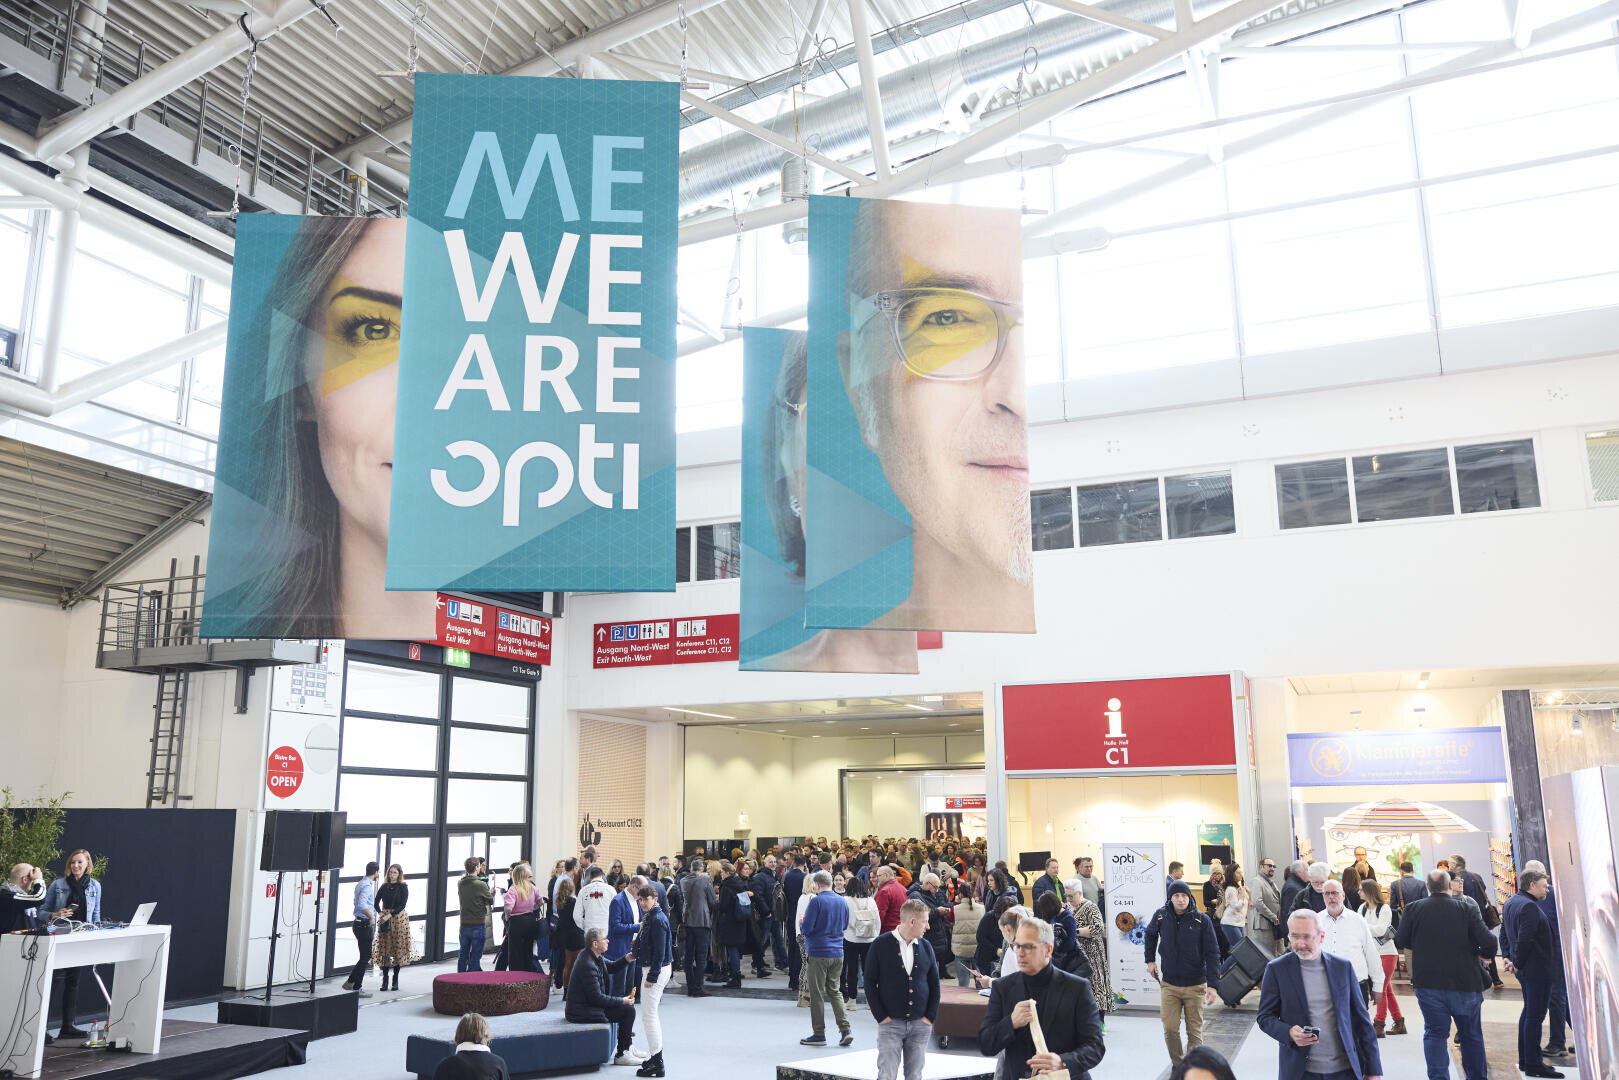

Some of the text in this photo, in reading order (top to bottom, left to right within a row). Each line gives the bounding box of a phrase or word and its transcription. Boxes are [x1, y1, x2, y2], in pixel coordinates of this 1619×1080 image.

[444, 131, 645, 223] ME
[443, 229, 643, 326] WE
[433, 333, 641, 414] ARE
[430, 423, 640, 527] opti
[446, 622, 486, 638] Ausgang West
[446, 633, 471, 646] Exit West
[497, 633, 550, 650] Ausgang Nord-West
[676, 640, 704, 648] Konferenz
[718, 637, 731, 645] C12
[497, 643, 538, 658] Exit North-West
[596, 642, 670, 655] Ausgang Nord-West
[675, 648, 707, 656] Conference
[596, 654, 652, 664] Exit North-West
[1105, 747, 1129, 765] C1
[270, 775, 297, 787] OPEN
[598, 819, 626, 828] Restaurant
[1112, 853, 1135, 866] opti
